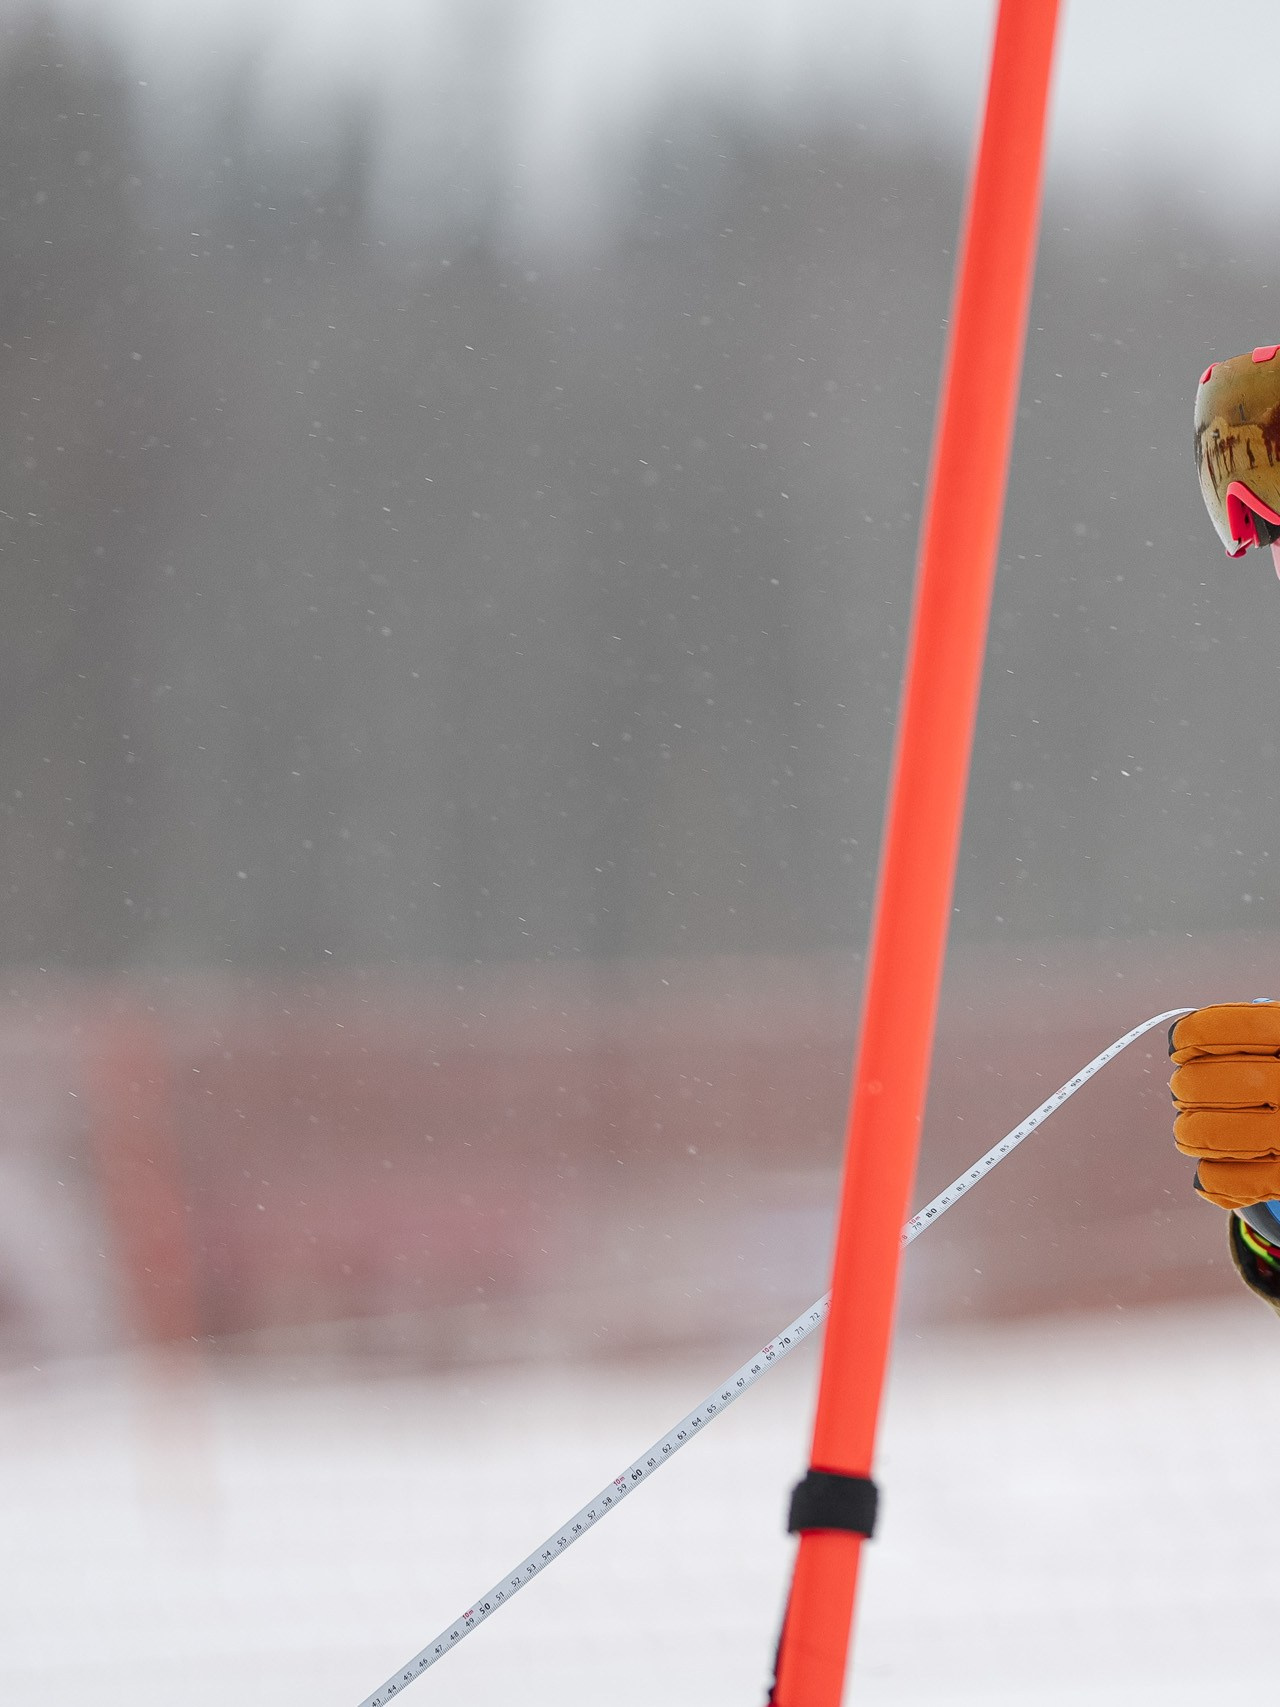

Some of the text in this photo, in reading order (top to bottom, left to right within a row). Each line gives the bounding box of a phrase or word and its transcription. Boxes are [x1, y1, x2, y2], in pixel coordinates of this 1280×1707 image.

[912, 1221, 922, 1231] 79
[926, 1208, 938, 1218] 80
[941, 1196, 951, 1205] 81
[762, 1344, 774, 1355] 10m
[613, 1476, 626, 1486] 10m
[388, 1684, 397, 1694] 44
[404, 1671, 413, 1681] 45
[419, 1658, 428, 1668] 46
[434, 1644, 444, 1654] 47
[450, 1630, 460, 1640] 48
[465, 1617, 475, 1628] 49
[480, 1602, 491, 1615] 50
[496, 1591, 505, 1601] 51
[510, 1576, 521, 1588] 52
[526, 1563, 537, 1574] 53
[542, 1550, 552, 1560] 54
[556, 1536, 567, 1547] 55
[572, 1524, 582, 1534] 56
[587, 1510, 596, 1520] 57
[602, 1496, 612, 1507] 58
[617, 1483, 627, 1494] 59
[631, 1468, 643, 1481] 60
[646, 1458, 656, 1468] 61
[662, 1443, 672, 1454] 62
[676, 1430, 687, 1441] 63
[692, 1417, 702, 1427] 64
[706, 1404, 717, 1414] 65
[722, 1390, 732, 1401] 66
[736, 1378, 746, 1388] 67
[751, 1364, 761, 1375] 68
[766, 1351, 776, 1361] 69
[779, 1337, 791, 1349] 70
[795, 1326, 805, 1335] 71
[810, 1312, 820, 1322] 72
[462, 1610, 474, 1620] 10m
